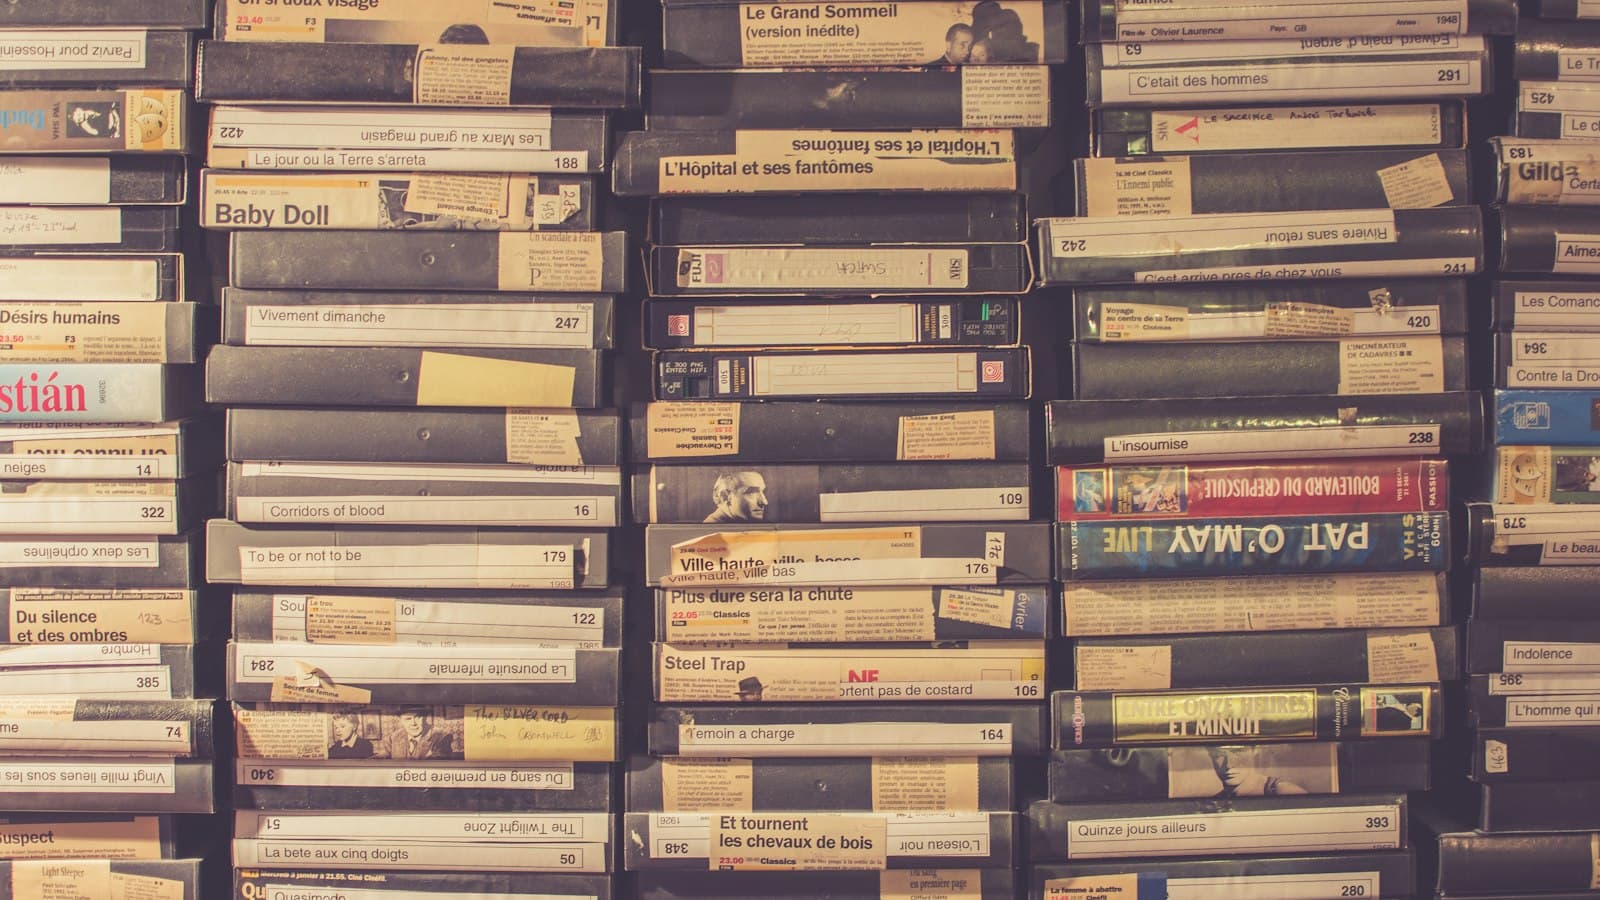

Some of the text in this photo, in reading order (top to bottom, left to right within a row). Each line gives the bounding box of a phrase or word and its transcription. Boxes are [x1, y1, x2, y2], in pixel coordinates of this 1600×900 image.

[747, 4, 898, 19] Le Grand Sommeil
[1436, 15, 1458, 24] 1948
[746, 24, 860, 40] (version inédite)
[1151, 26, 1224, 36] Olivier Laurence
[59, 44, 132, 58] Parviz pour
[1137, 74, 1268, 88] C'etait des hommes
[1438, 70, 1461, 81] 291
[1531, 92, 1555, 104] 425
[220, 127, 243, 138] 422
[361, 130, 543, 146] Les Marx au grand magasin
[256, 153, 426, 167] Le jour ou la Terre s'arreta
[554, 158, 578, 168] 188
[665, 159, 874, 179] L'Hôpital et ses fantômes
[215, 203, 329, 227] Baby Doll
[1265, 228, 1387, 243] Riviere sans retour
[1062, 240, 1086, 251] 242
[692, 254, 702, 283] FUJI
[0, 310, 120, 324] Désirs humains
[259, 309, 385, 323] Vivement dimanche
[1106, 307, 1134, 315] Voyage
[555, 317, 579, 329] 247
[1408, 316, 1430, 328] 420
[1524, 342, 1547, 354] 364
[1516, 370, 1573, 382] Contre la
[1409, 432, 1433, 444] 238
[1112, 439, 1189, 452] L'insoumise
[4, 463, 151, 476] neiges 14
[1284, 477, 1300, 496] DU
[1305, 476, 1380, 496] BOULEVARD
[999, 493, 1023, 505] 109
[141, 507, 165, 518] 322
[270, 505, 384, 517] Corridors of blood
[574, 505, 589, 516] 16
[1504, 517, 1526, 529] 378
[1103, 522, 1369, 554] PAT O'MAY LIVE
[24, 545, 149, 558] Les deux orphelines
[248, 550, 361, 561] To be or not to be
[543, 552, 566, 562] 179
[966, 564, 989, 574] 176
[672, 587, 853, 604] Plus dure sera la chute
[17, 610, 97, 623] Du silence
[138, 614, 162, 625] 123
[572, 613, 595, 625] 122
[17, 629, 128, 641] et des ombres
[1513, 648, 1573, 659] Indolence
[251, 660, 274, 671] 284
[429, 664, 567, 676] La poursuite infernale
[665, 656, 745, 673] Steel Trap
[136, 677, 159, 688] 385
[1500, 674, 1522, 685] 395
[879, 684, 1038, 698] pas de costard 106
[1515, 705, 1593, 718] L'homme qui
[166, 727, 181, 738] 74
[1169, 717, 1260, 736] ET MINUIT
[739, 728, 795, 741] a charge
[980, 729, 1003, 740] 164
[5, 772, 166, 783] Vingt mille lieues sous les
[251, 769, 274, 780] 340
[395, 771, 563, 784] Du sang en premiere page
[464, 821, 576, 835] The Twilight Zone
[720, 816, 808, 831] Et tournent
[1366, 817, 1388, 828] 393
[1078, 822, 1206, 837] Quinze jours ailleurs
[719, 834, 873, 849] les chevaux de bois
[265, 848, 409, 861] La bete aux cinq doigts
[665, 843, 688, 854] 348
[560, 854, 576, 865] 50
[1341, 886, 1364, 896] 280
